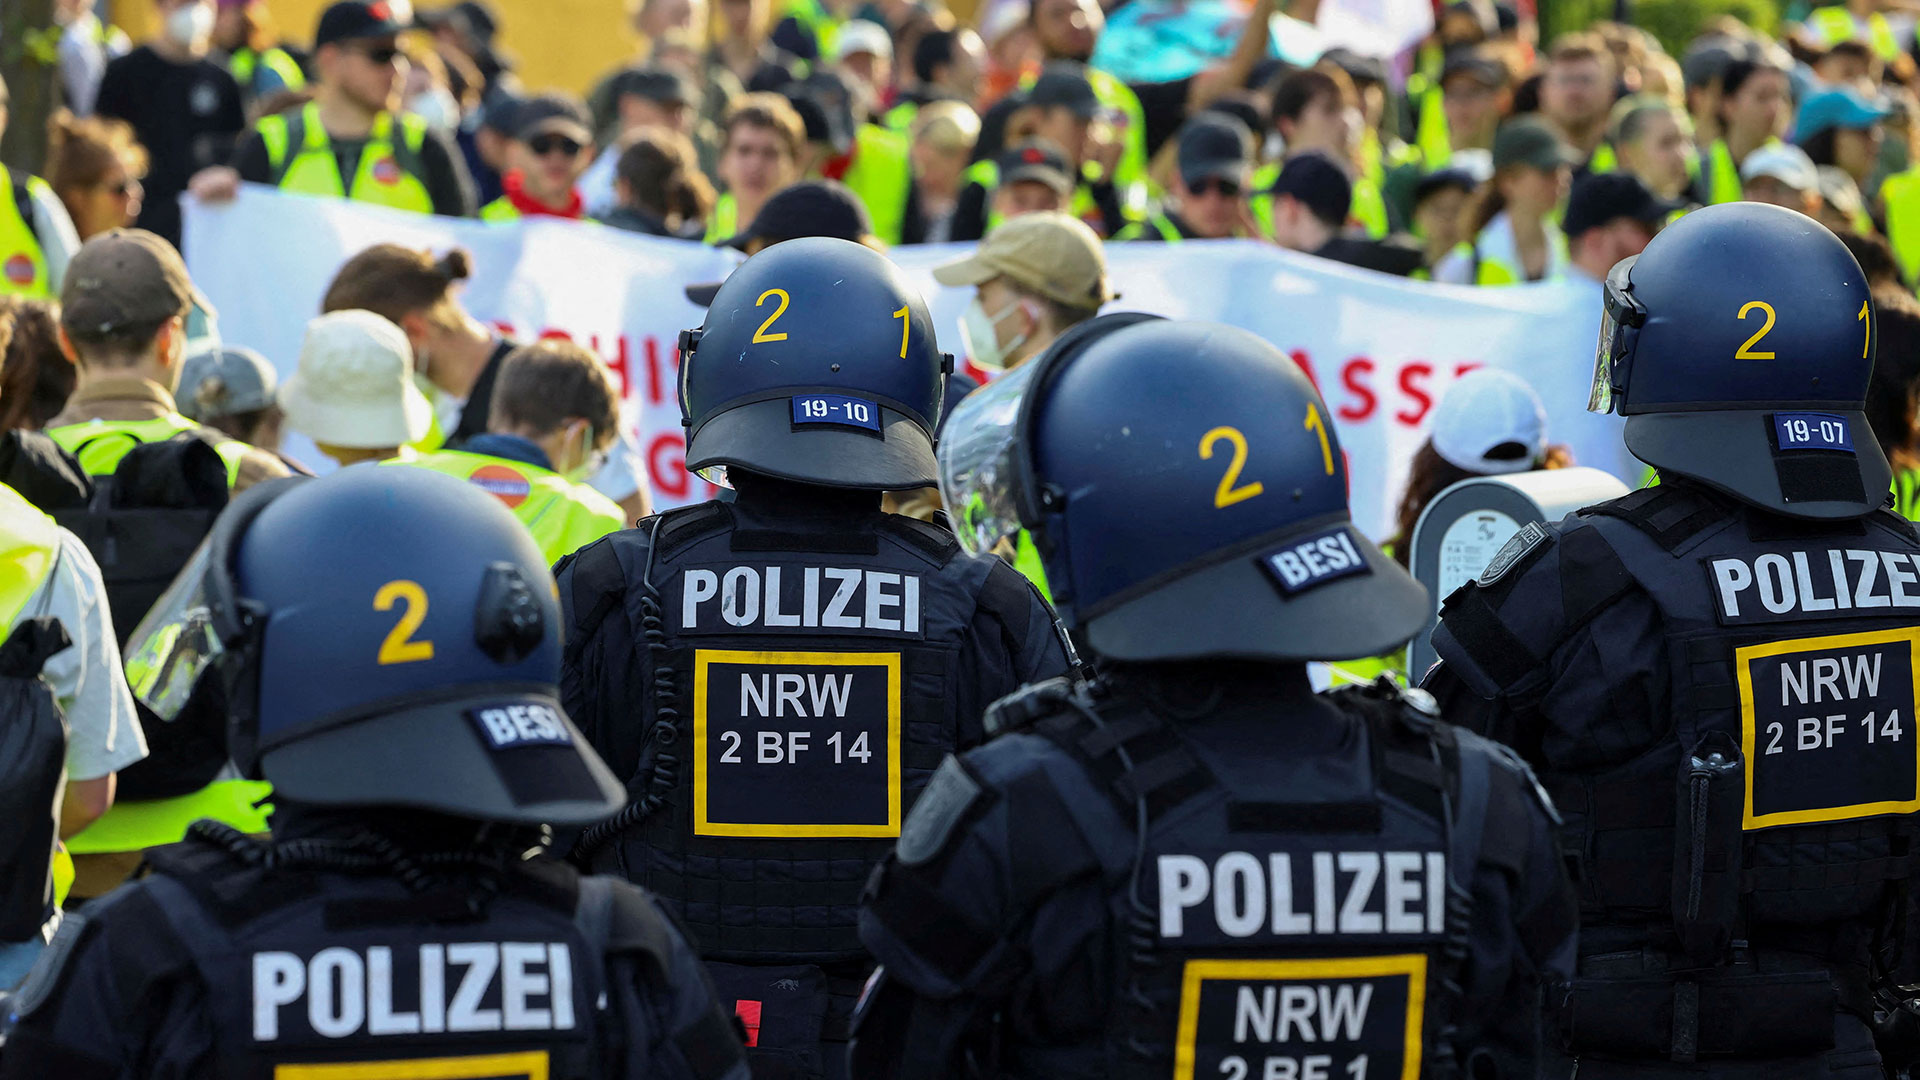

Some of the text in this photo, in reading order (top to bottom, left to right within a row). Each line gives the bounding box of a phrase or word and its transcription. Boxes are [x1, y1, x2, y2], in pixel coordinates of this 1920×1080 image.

[752, 288, 909, 359] 2 1
[1735, 300, 1870, 360] 2 1
[801, 400, 868, 422] 19-10
[1783, 419, 1844, 444] 19-07
[1199, 426, 1264, 509] 2
[1304, 402, 1334, 476] 1
[1271, 532, 1362, 587] BESI
[373, 579, 434, 665] 2
[682, 566, 920, 633] POLIZEI
[740, 673, 853, 717] NRW
[1780, 652, 1882, 706] NRW
[720, 731, 871, 764] 2 BF 14
[1765, 709, 1902, 755] 2 BF 14
[1157, 851, 1446, 938] POLIZEI
[253, 942, 575, 1041] POLIZEI
[1233, 983, 1374, 1043] NRW
